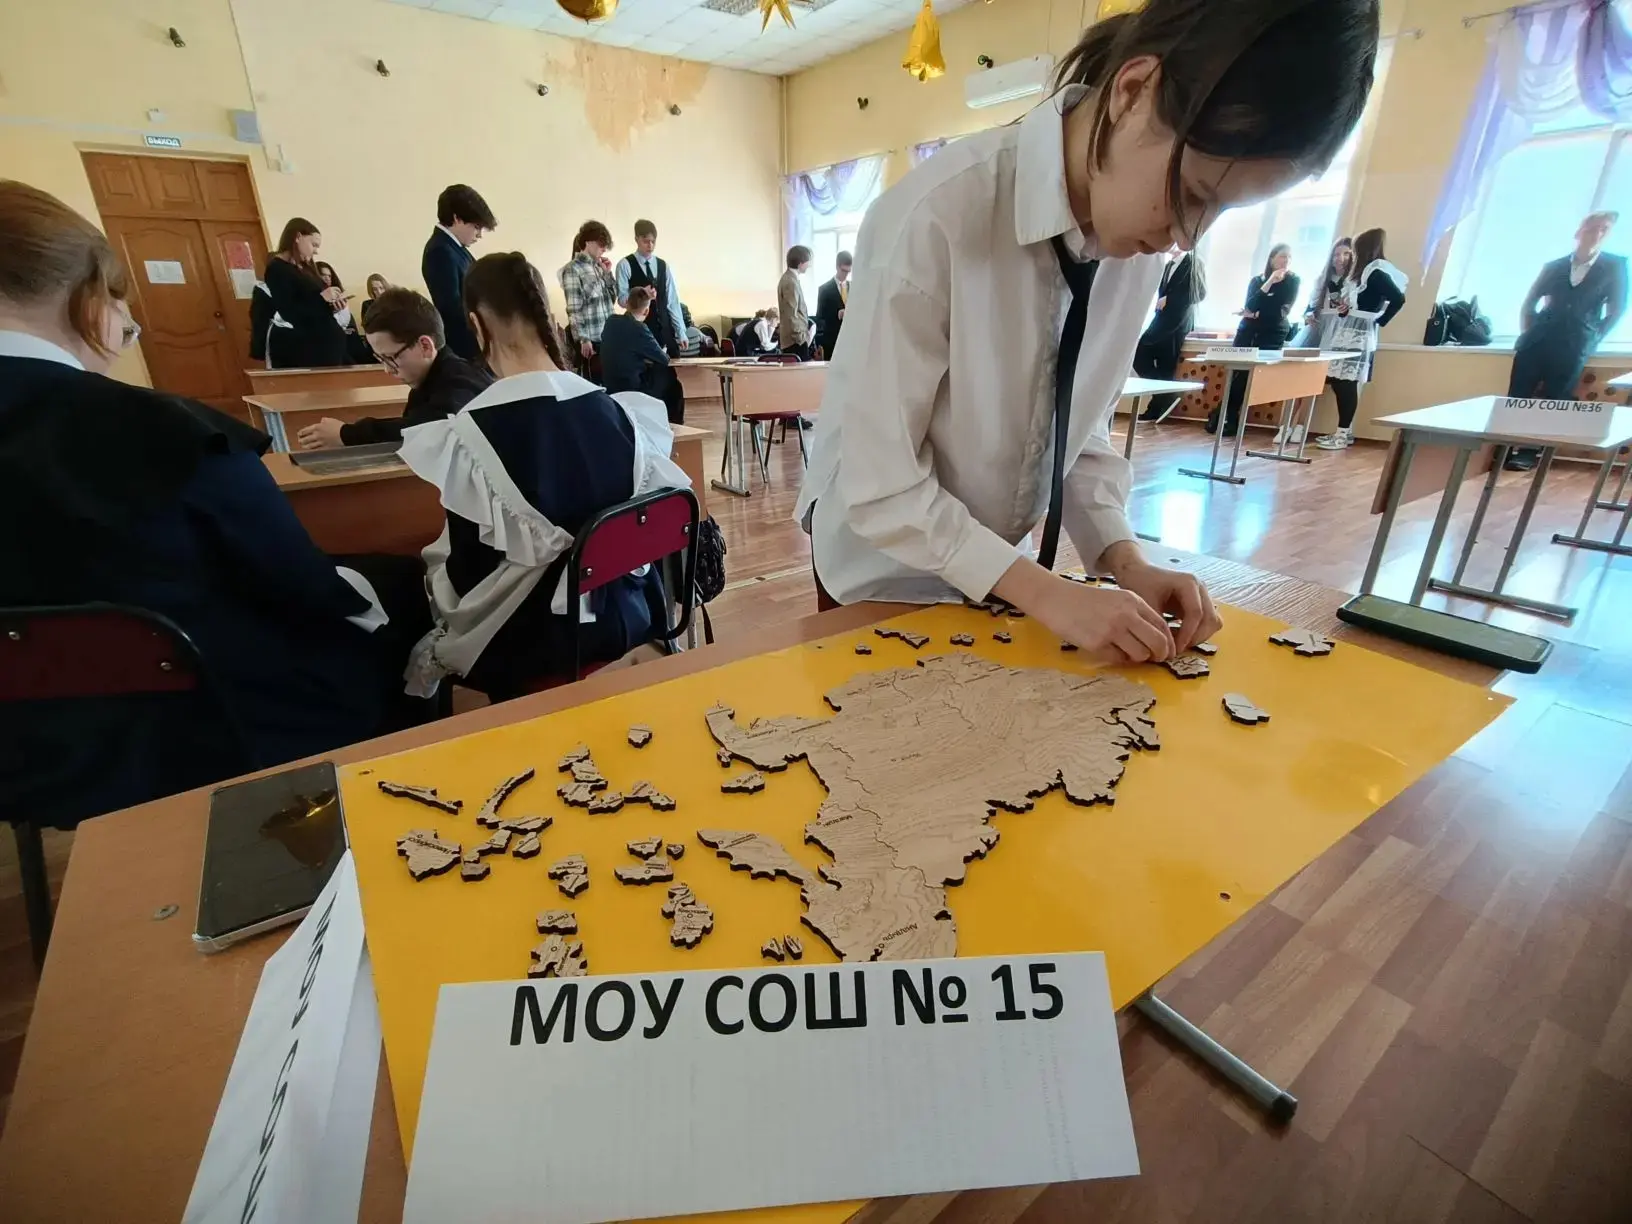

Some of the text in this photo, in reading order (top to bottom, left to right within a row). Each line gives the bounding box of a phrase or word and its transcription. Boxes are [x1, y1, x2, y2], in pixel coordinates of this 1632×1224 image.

[147, 136, 180, 146] ВЫХОД
[1505, 397, 1603, 413] МОУ СОШ №36
[882, 922, 918, 941] Анадырь
[291, 889, 338, 1030] МОУ
[509, 962, 1064, 1046] МОУ СОШ № 15
